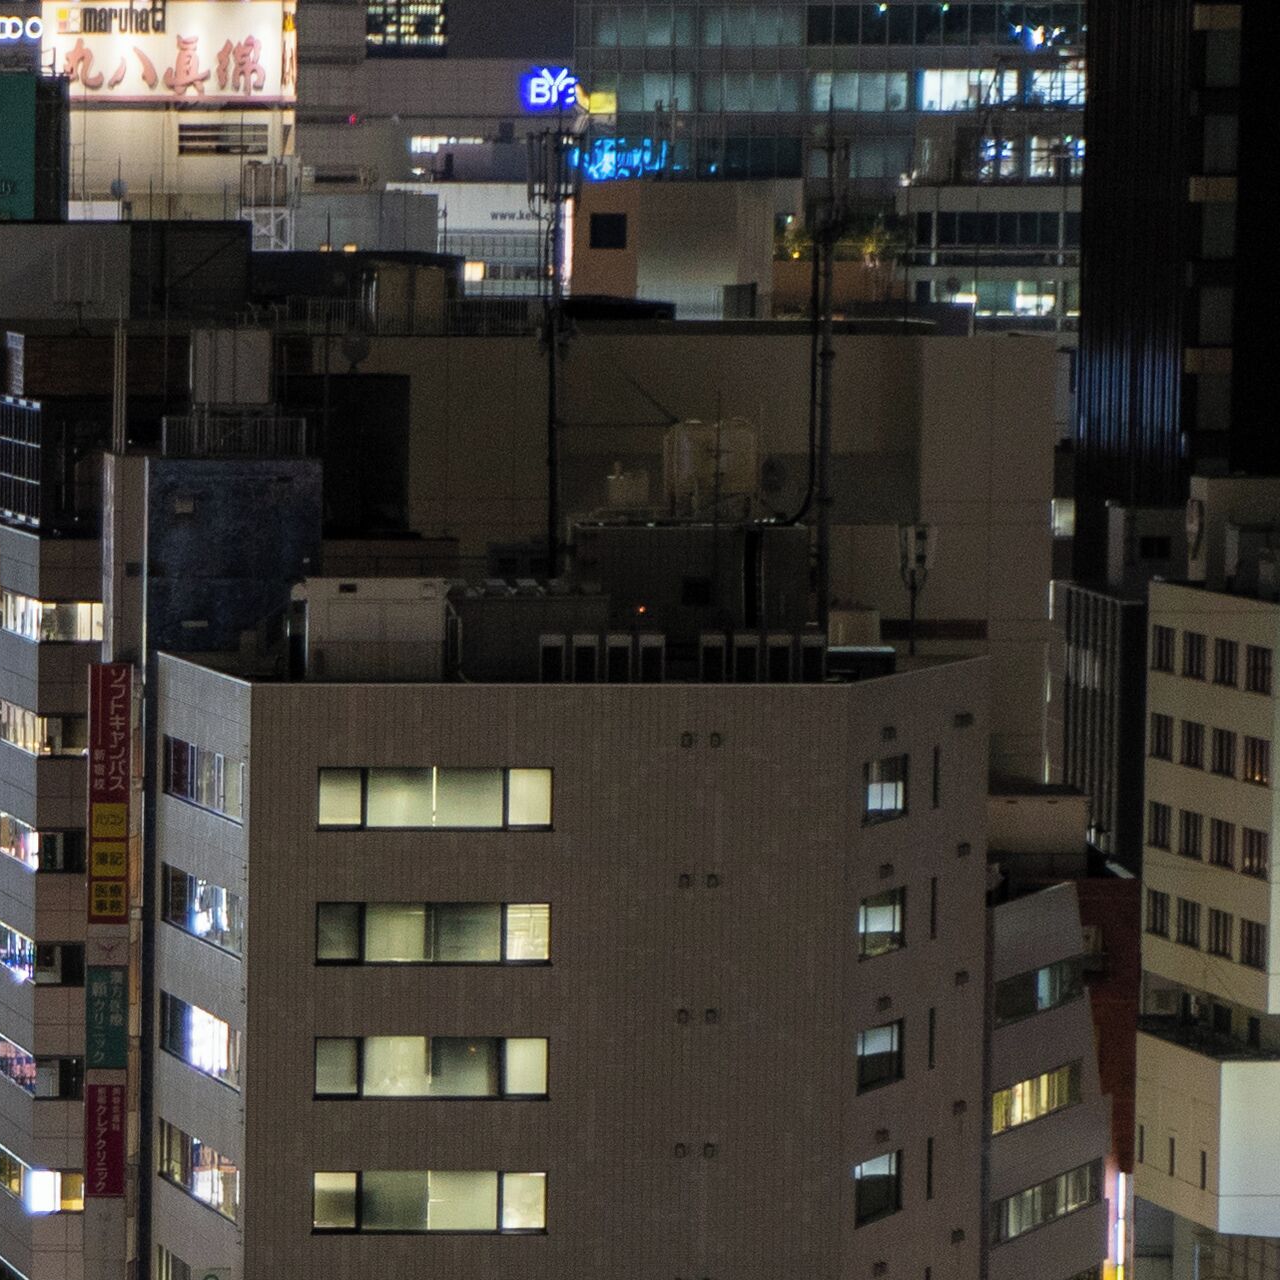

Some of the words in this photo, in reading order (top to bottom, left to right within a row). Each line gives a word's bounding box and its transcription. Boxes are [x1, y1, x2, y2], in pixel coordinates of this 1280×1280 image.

[95, 852, 124, 866] 簿記
[95, 885, 122, 898] 医療
[95, 899, 122, 913] 事務
